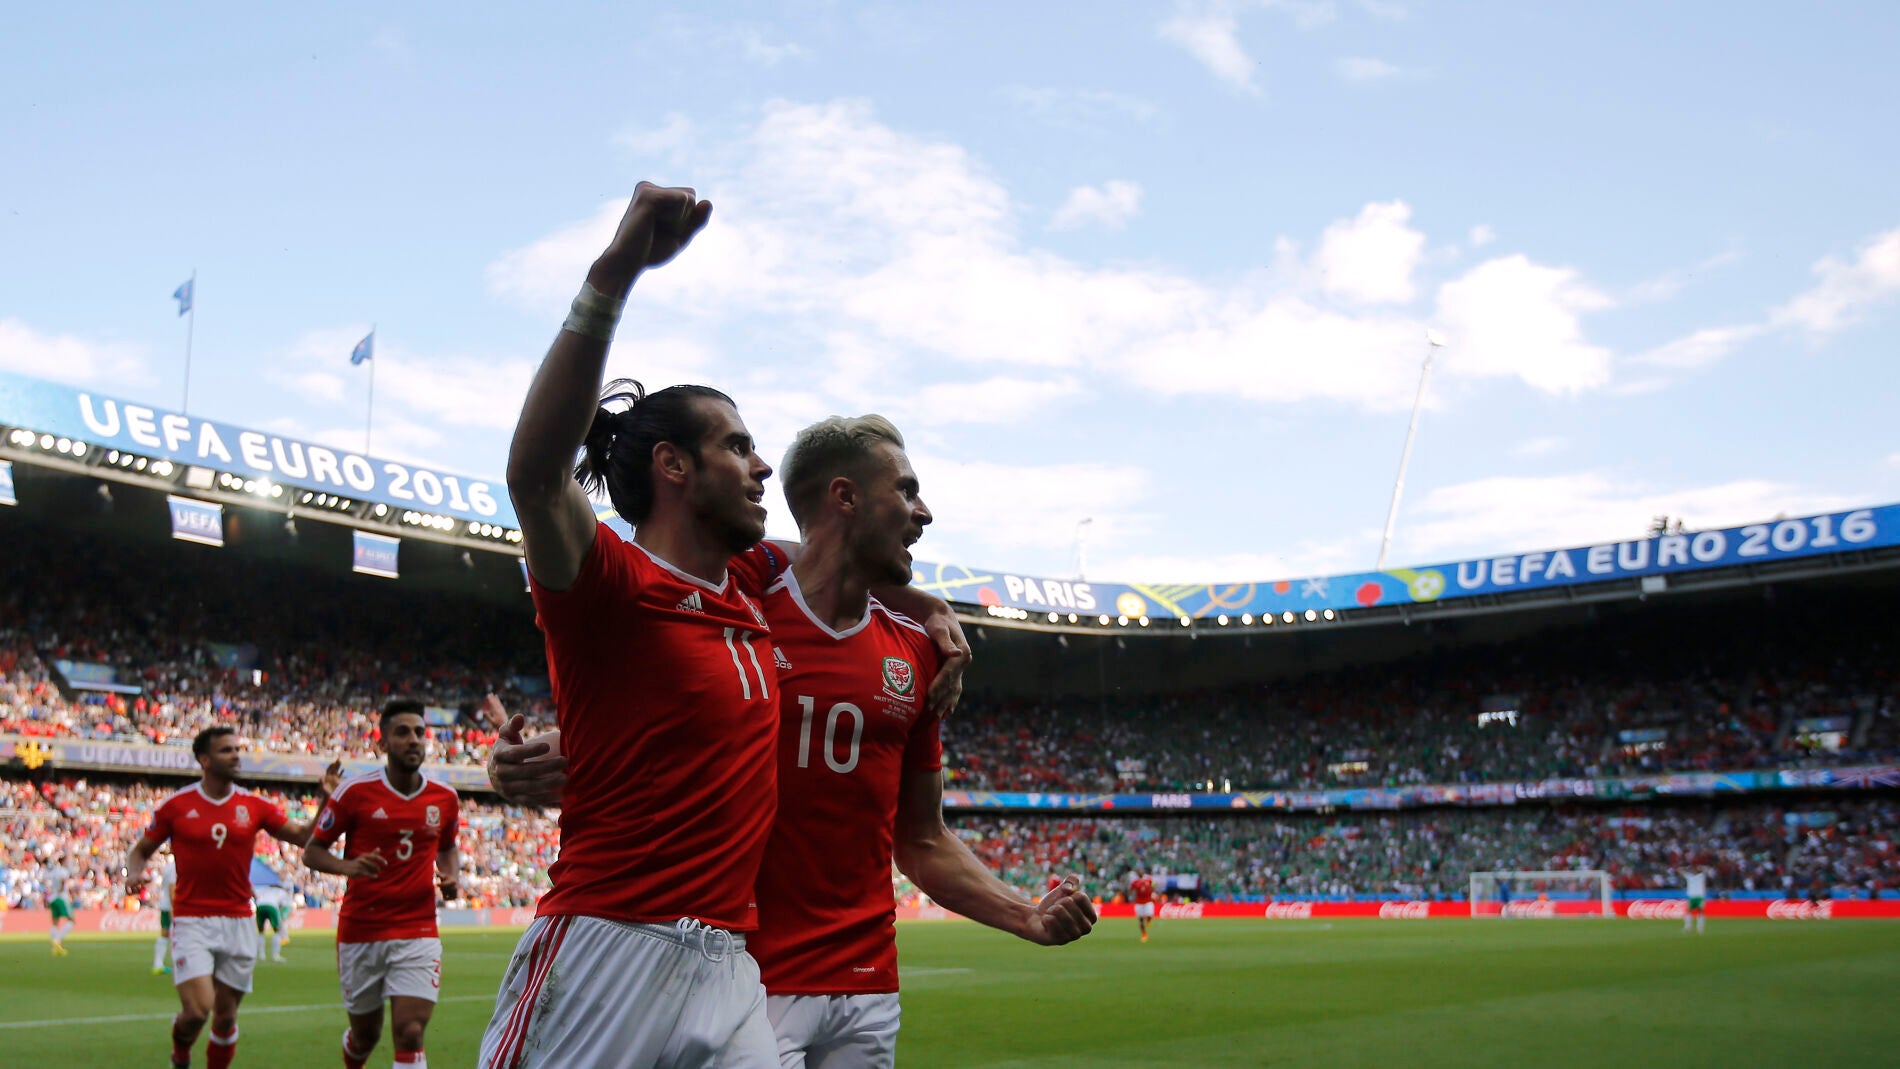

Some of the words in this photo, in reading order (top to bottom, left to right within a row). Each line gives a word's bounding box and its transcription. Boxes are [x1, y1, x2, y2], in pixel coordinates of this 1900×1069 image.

[78, 393, 232, 463] UEFA
[239, 431, 375, 492] EURO
[383, 463, 498, 516] 2016
[175, 510, 221, 534] UEFA
[1457, 551, 1575, 589] UEFA
[1586, 531, 1726, 574] EURO
[1738, 510, 1876, 556] 2016
[1003, 574, 1096, 610] PARIS
[723, 627, 769, 700] 11
[774, 659, 793, 670] das
[797, 695, 864, 774] 10
[81, 745, 134, 764] UEFA
[138, 750, 190, 768] EURO
[1152, 793, 1192, 808] PARIS
[211, 822, 228, 849] 9
[396, 829, 415, 861] 3
